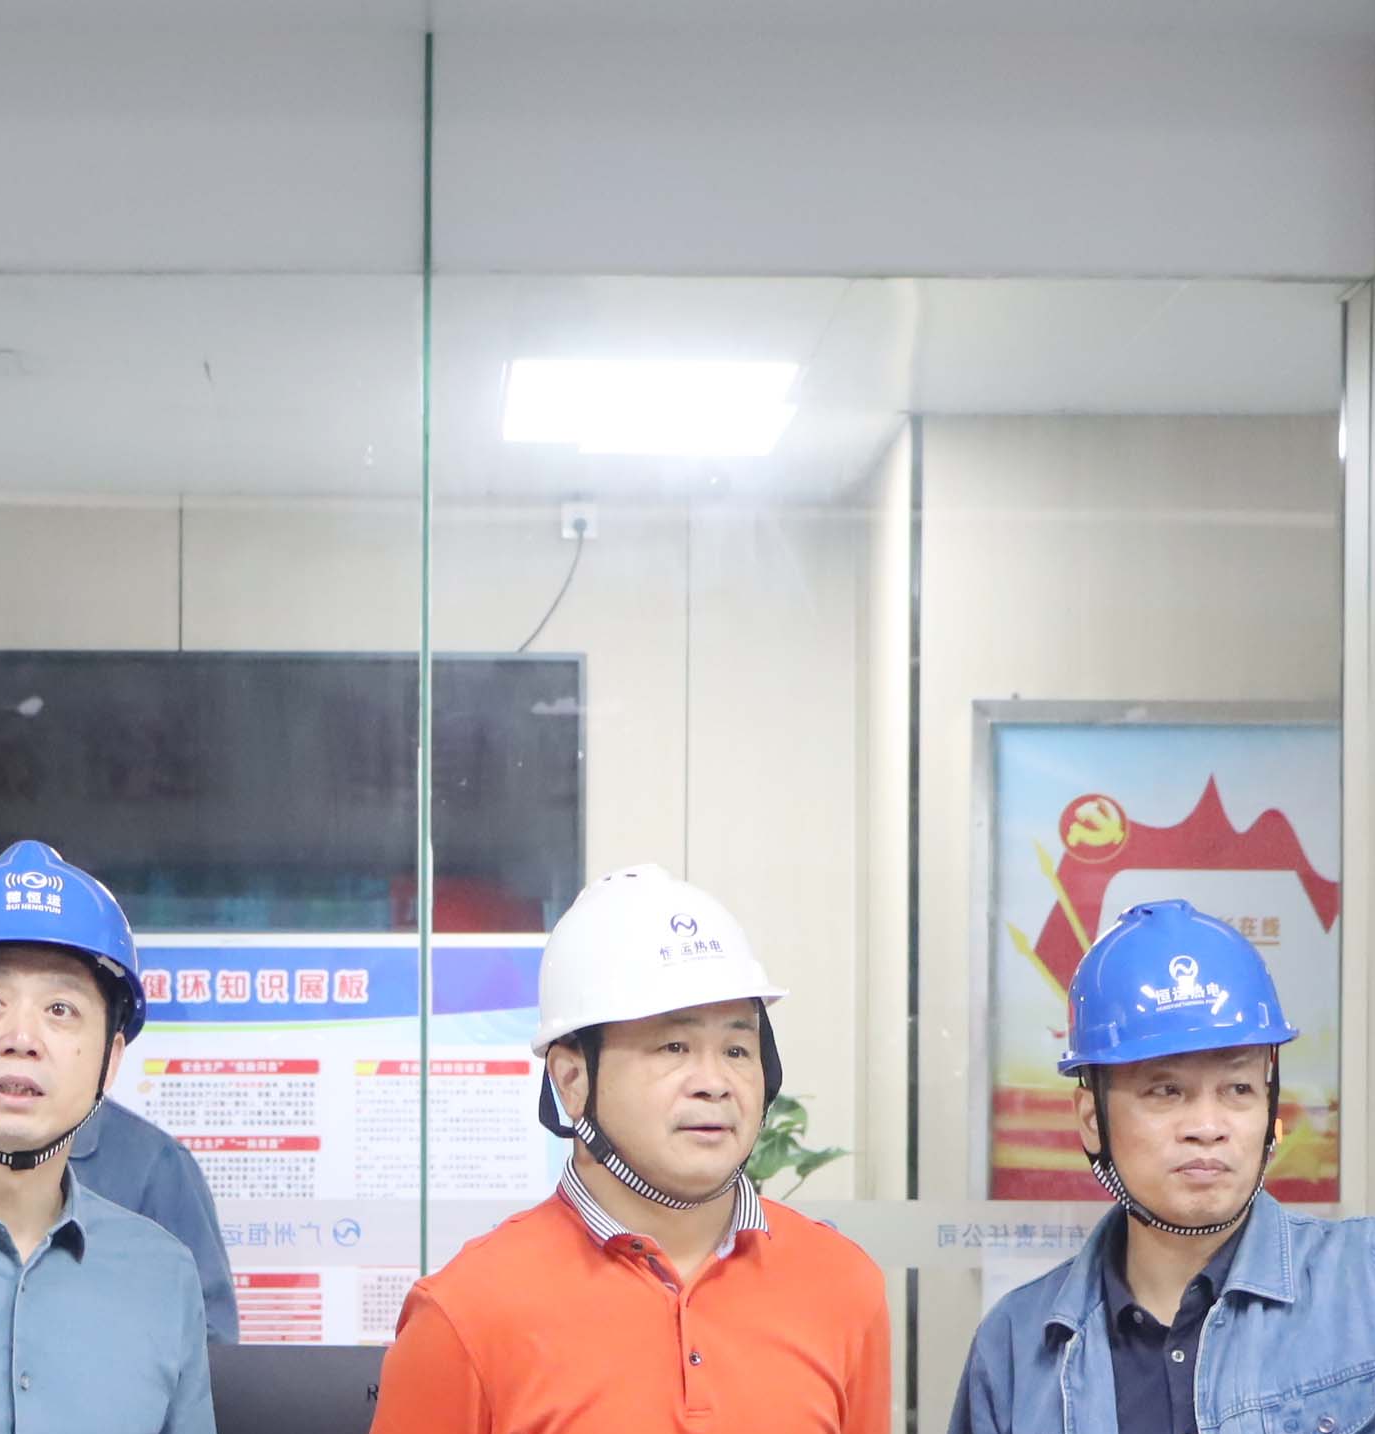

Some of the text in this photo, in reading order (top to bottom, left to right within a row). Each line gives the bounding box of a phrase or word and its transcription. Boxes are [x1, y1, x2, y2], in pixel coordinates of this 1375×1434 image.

[659, 938, 724, 961] 恒运热电
[141, 969, 369, 1004] 健环知识展板
